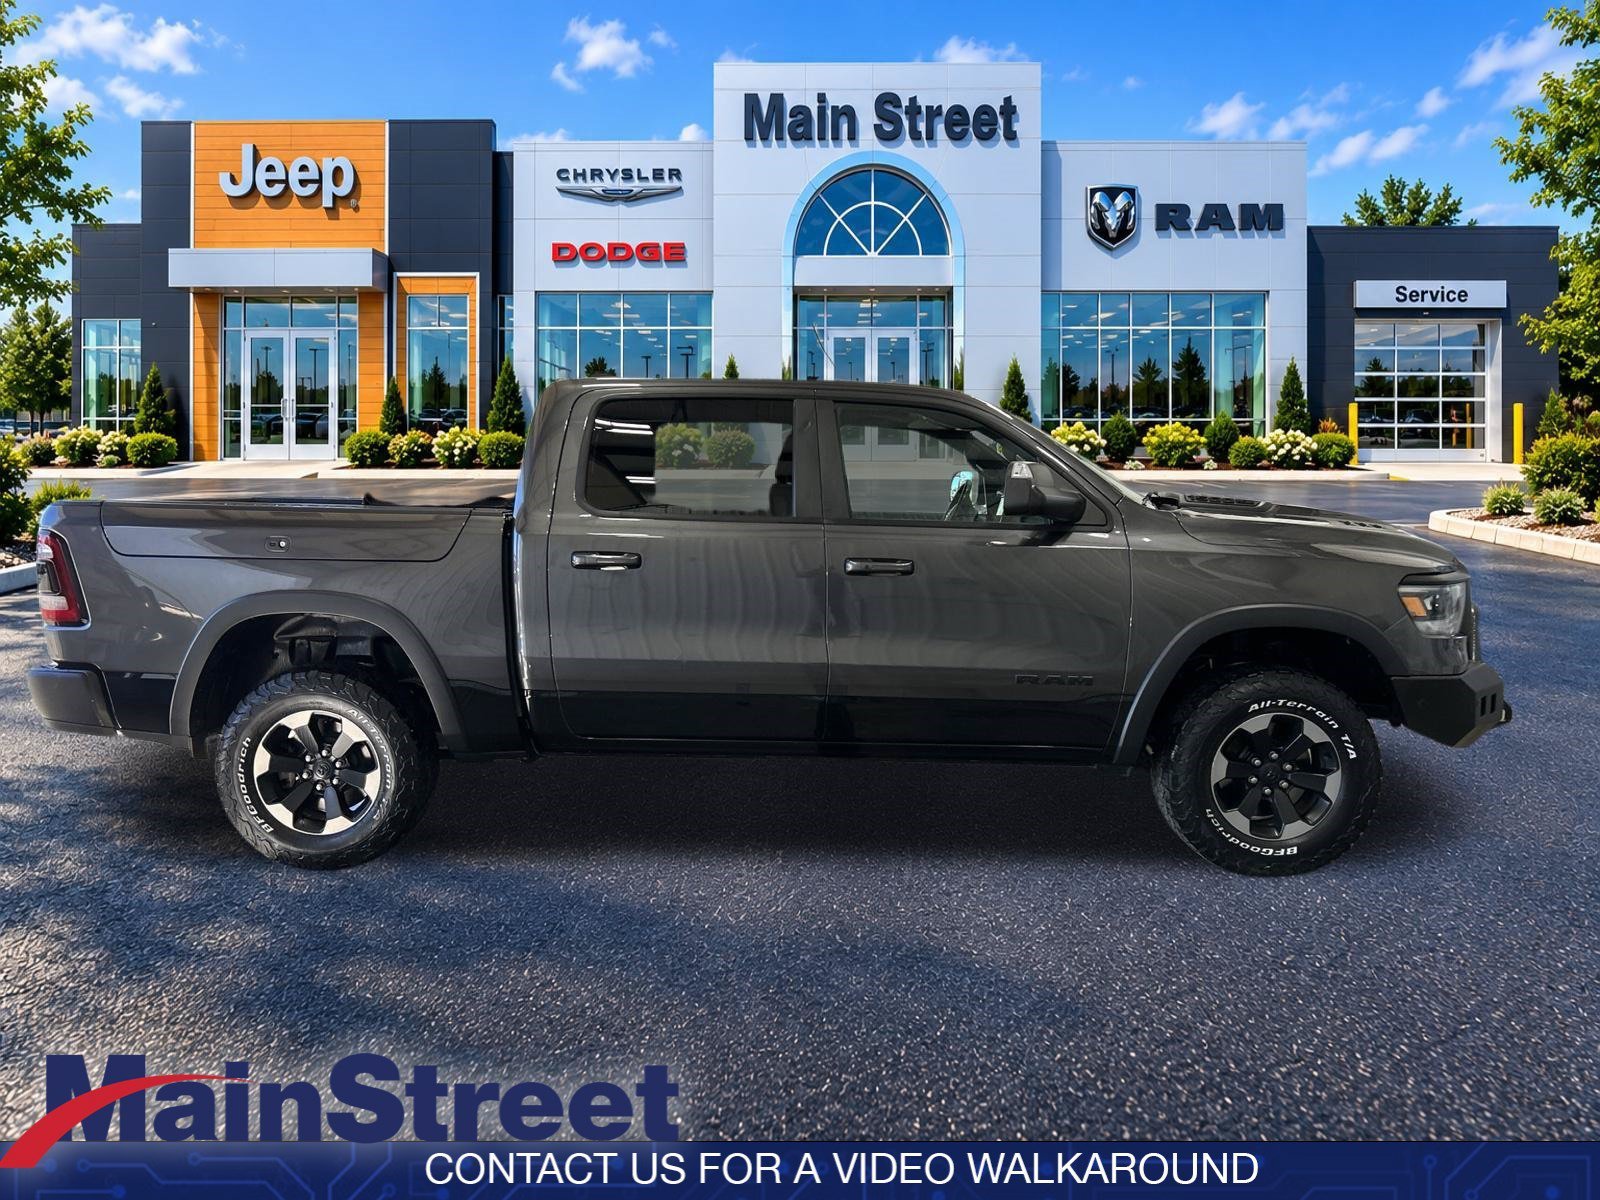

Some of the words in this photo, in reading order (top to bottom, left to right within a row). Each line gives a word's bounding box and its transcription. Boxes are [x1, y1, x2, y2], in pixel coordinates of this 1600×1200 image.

[744, 93, 857, 141] Main
[873, 91, 1018, 141] Street
[218, 143, 355, 208] Jeep
[556, 168, 683, 182] CHRYSLER
[1155, 203, 1285, 231] RAM
[551, 242, 687, 261] DODGE
[1395, 286, 1469, 303] Service
[1014, 673, 1095, 686] RAM
[1248, 699, 1340, 731] All-Terrain
[1340, 733, 1358, 761] T/A
[236, 736, 275, 834] BFGoodrich
[1205, 808, 1299, 857] BFGoodrich
